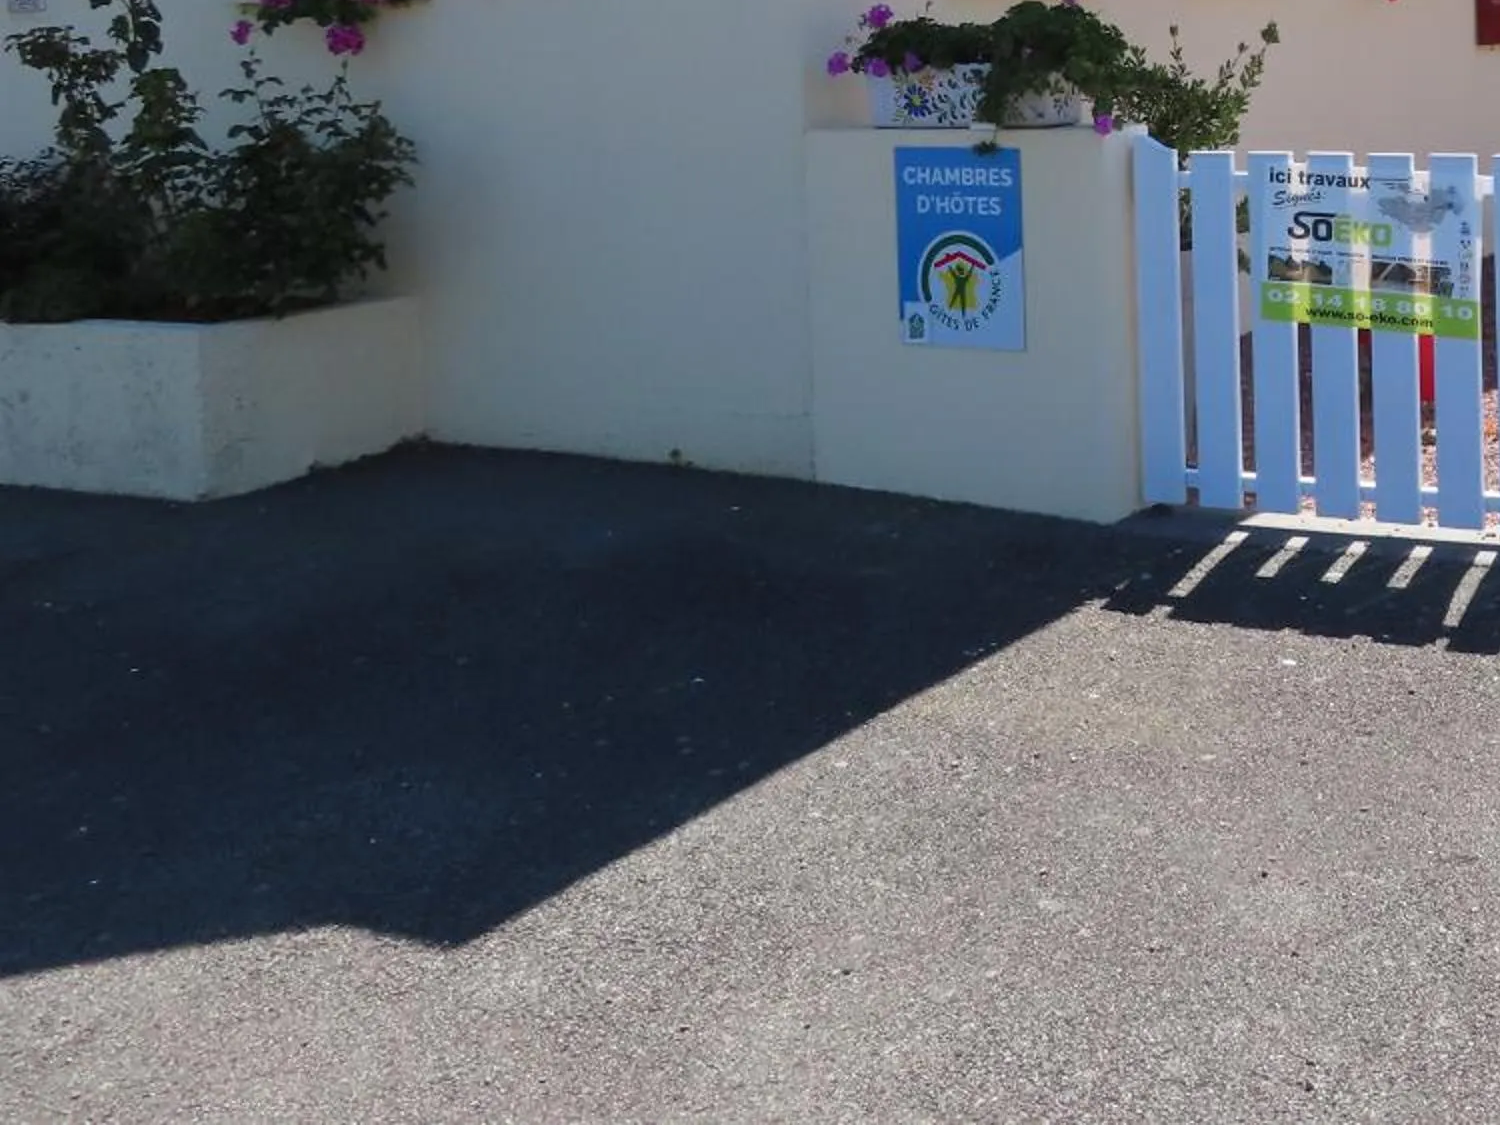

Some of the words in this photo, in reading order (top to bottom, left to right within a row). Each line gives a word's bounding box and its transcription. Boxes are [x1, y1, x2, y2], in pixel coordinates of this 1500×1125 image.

[903, 166, 1013, 187] CHAMBRES
[1269, 166, 1292, 185] ici
[1298, 171, 1371, 190] travaux
[916, 192, 1002, 216] D'HÔTES
[1305, 307, 1433, 328] www.so-eko.com
